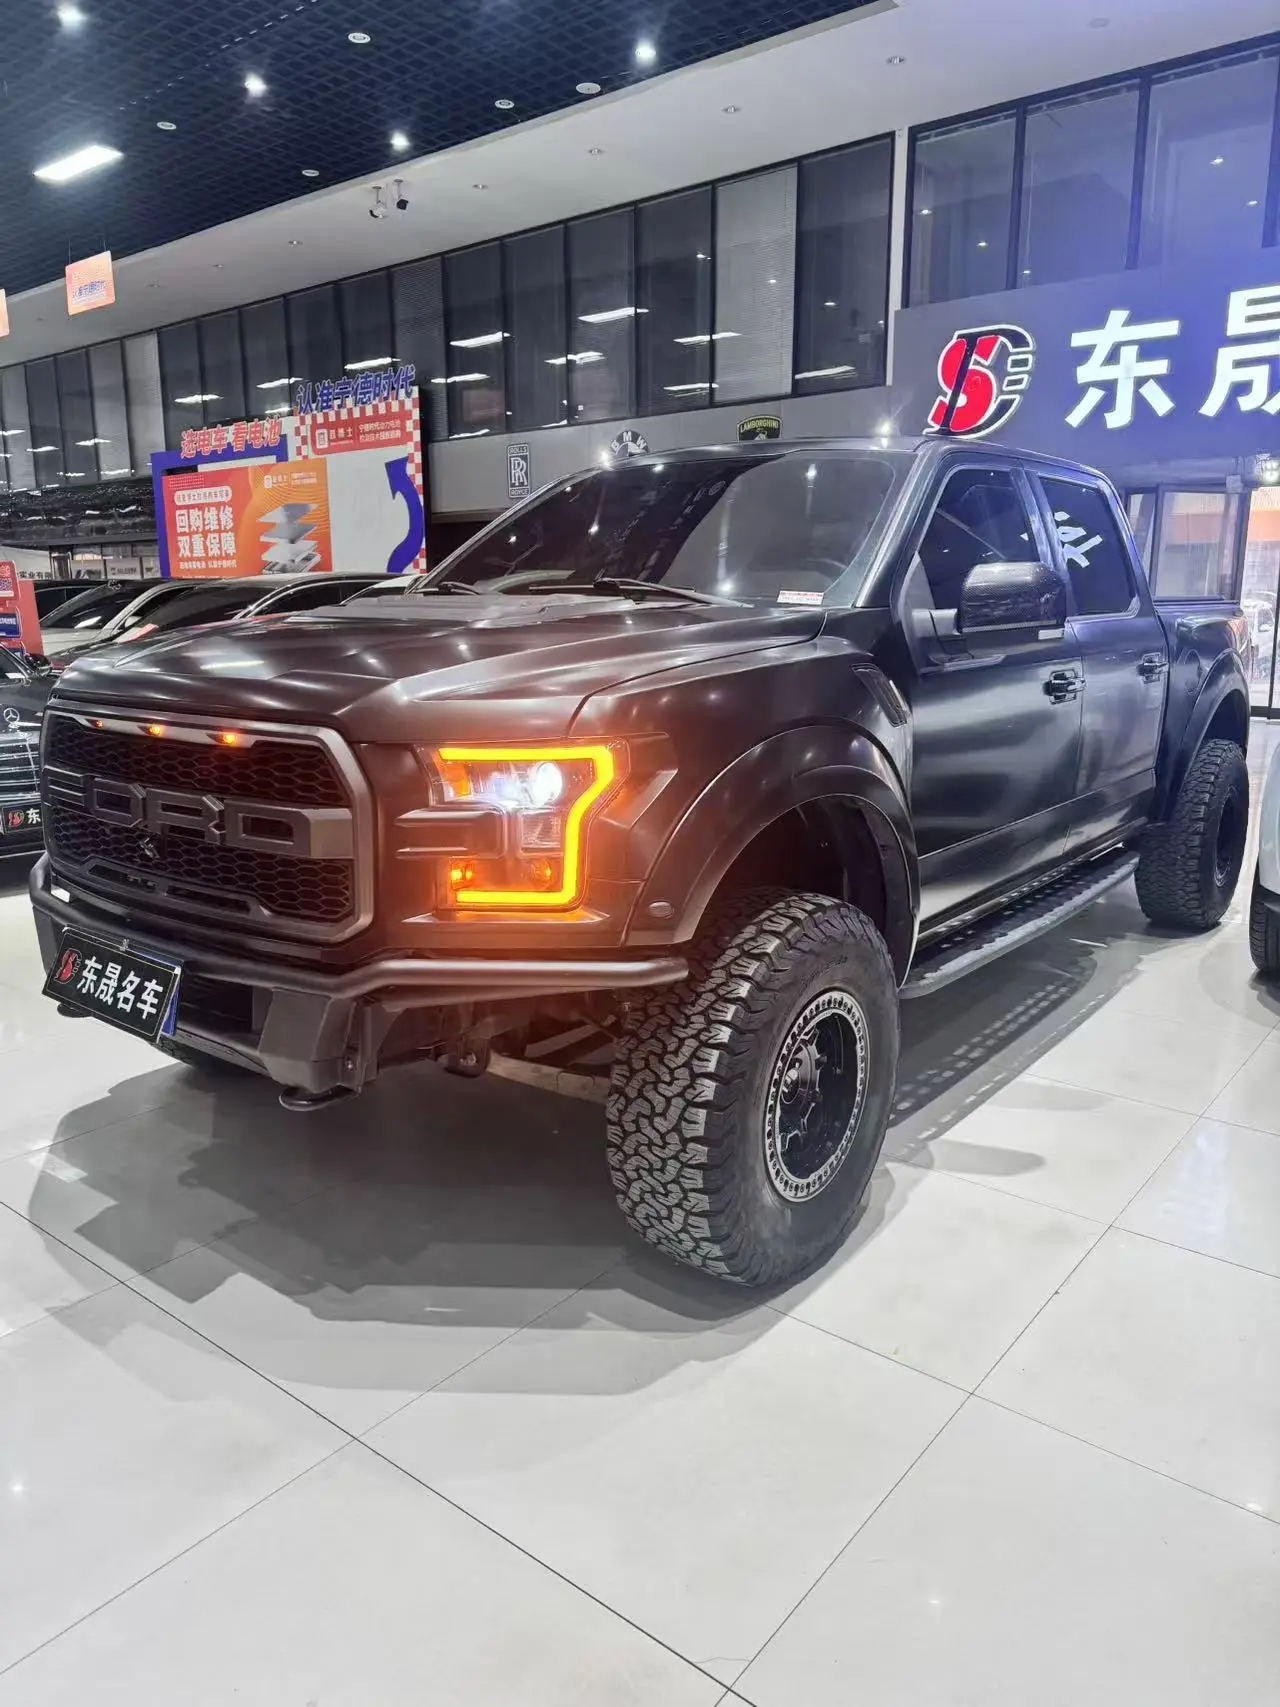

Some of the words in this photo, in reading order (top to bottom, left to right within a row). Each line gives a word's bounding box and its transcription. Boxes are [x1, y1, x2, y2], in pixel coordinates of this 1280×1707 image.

[296, 364, 416, 415] 认准宁德时代
[180, 424, 227, 459] 选电车
[231, 416, 282, 453] 看电池
[740, 418, 779, 433] LAMBORGHINI
[611, 430, 647, 453] BMW
[175, 505, 234, 533] 回购维修
[177, 532, 237, 558] 双重保障
[26, 808, 41, 824] 东
[44, 765, 311, 858] FORD
[76, 955, 164, 1020] 东晟名车
